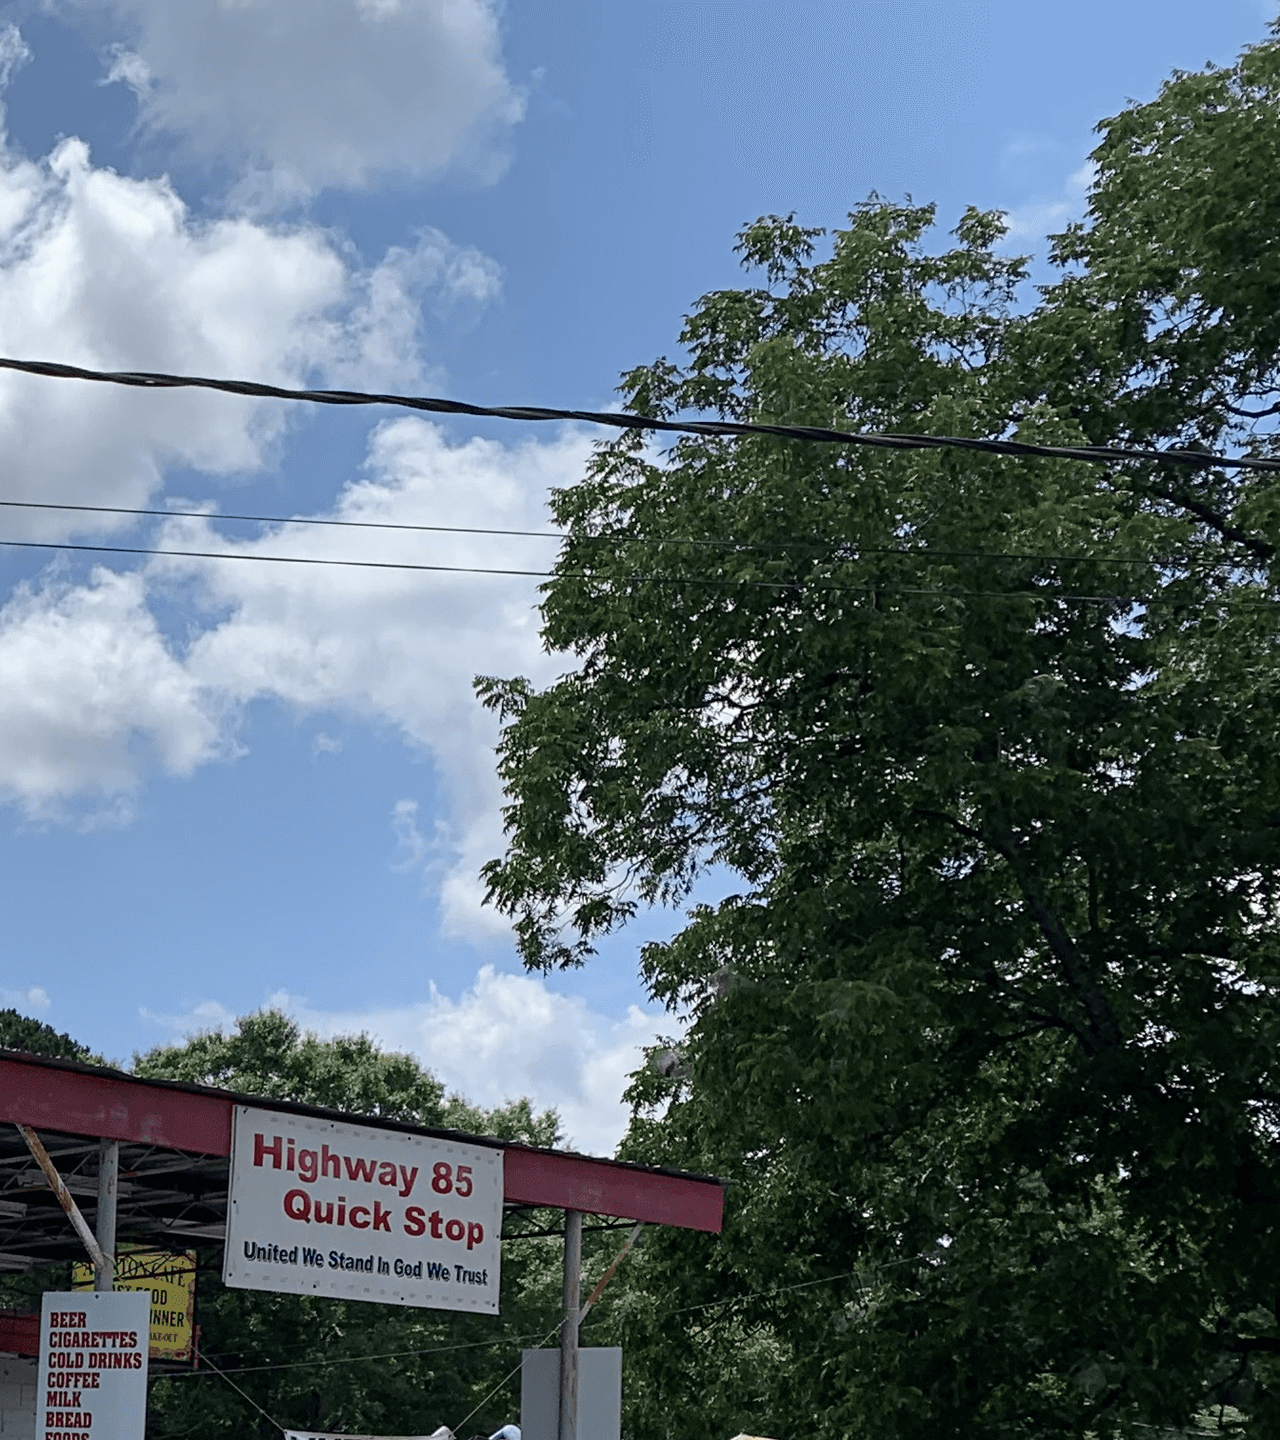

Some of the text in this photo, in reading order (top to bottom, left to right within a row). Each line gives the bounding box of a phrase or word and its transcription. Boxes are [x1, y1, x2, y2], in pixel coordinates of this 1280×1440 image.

[253, 1133, 474, 1198] Highway 85
[283, 1188, 484, 1250] Quick Stop
[243, 1240, 489, 1287] United We Stand In God We Trust
[50, 1311, 87, 1328] BEER
[150, 1309, 185, 1327] INNER
[49, 1331, 138, 1348] CIGARETTES
[48, 1352, 142, 1369] COLD DRINKS
[47, 1371, 100, 1389] COFFEE
[46, 1391, 81, 1407] MILK
[45, 1411, 92, 1428] BREAD
